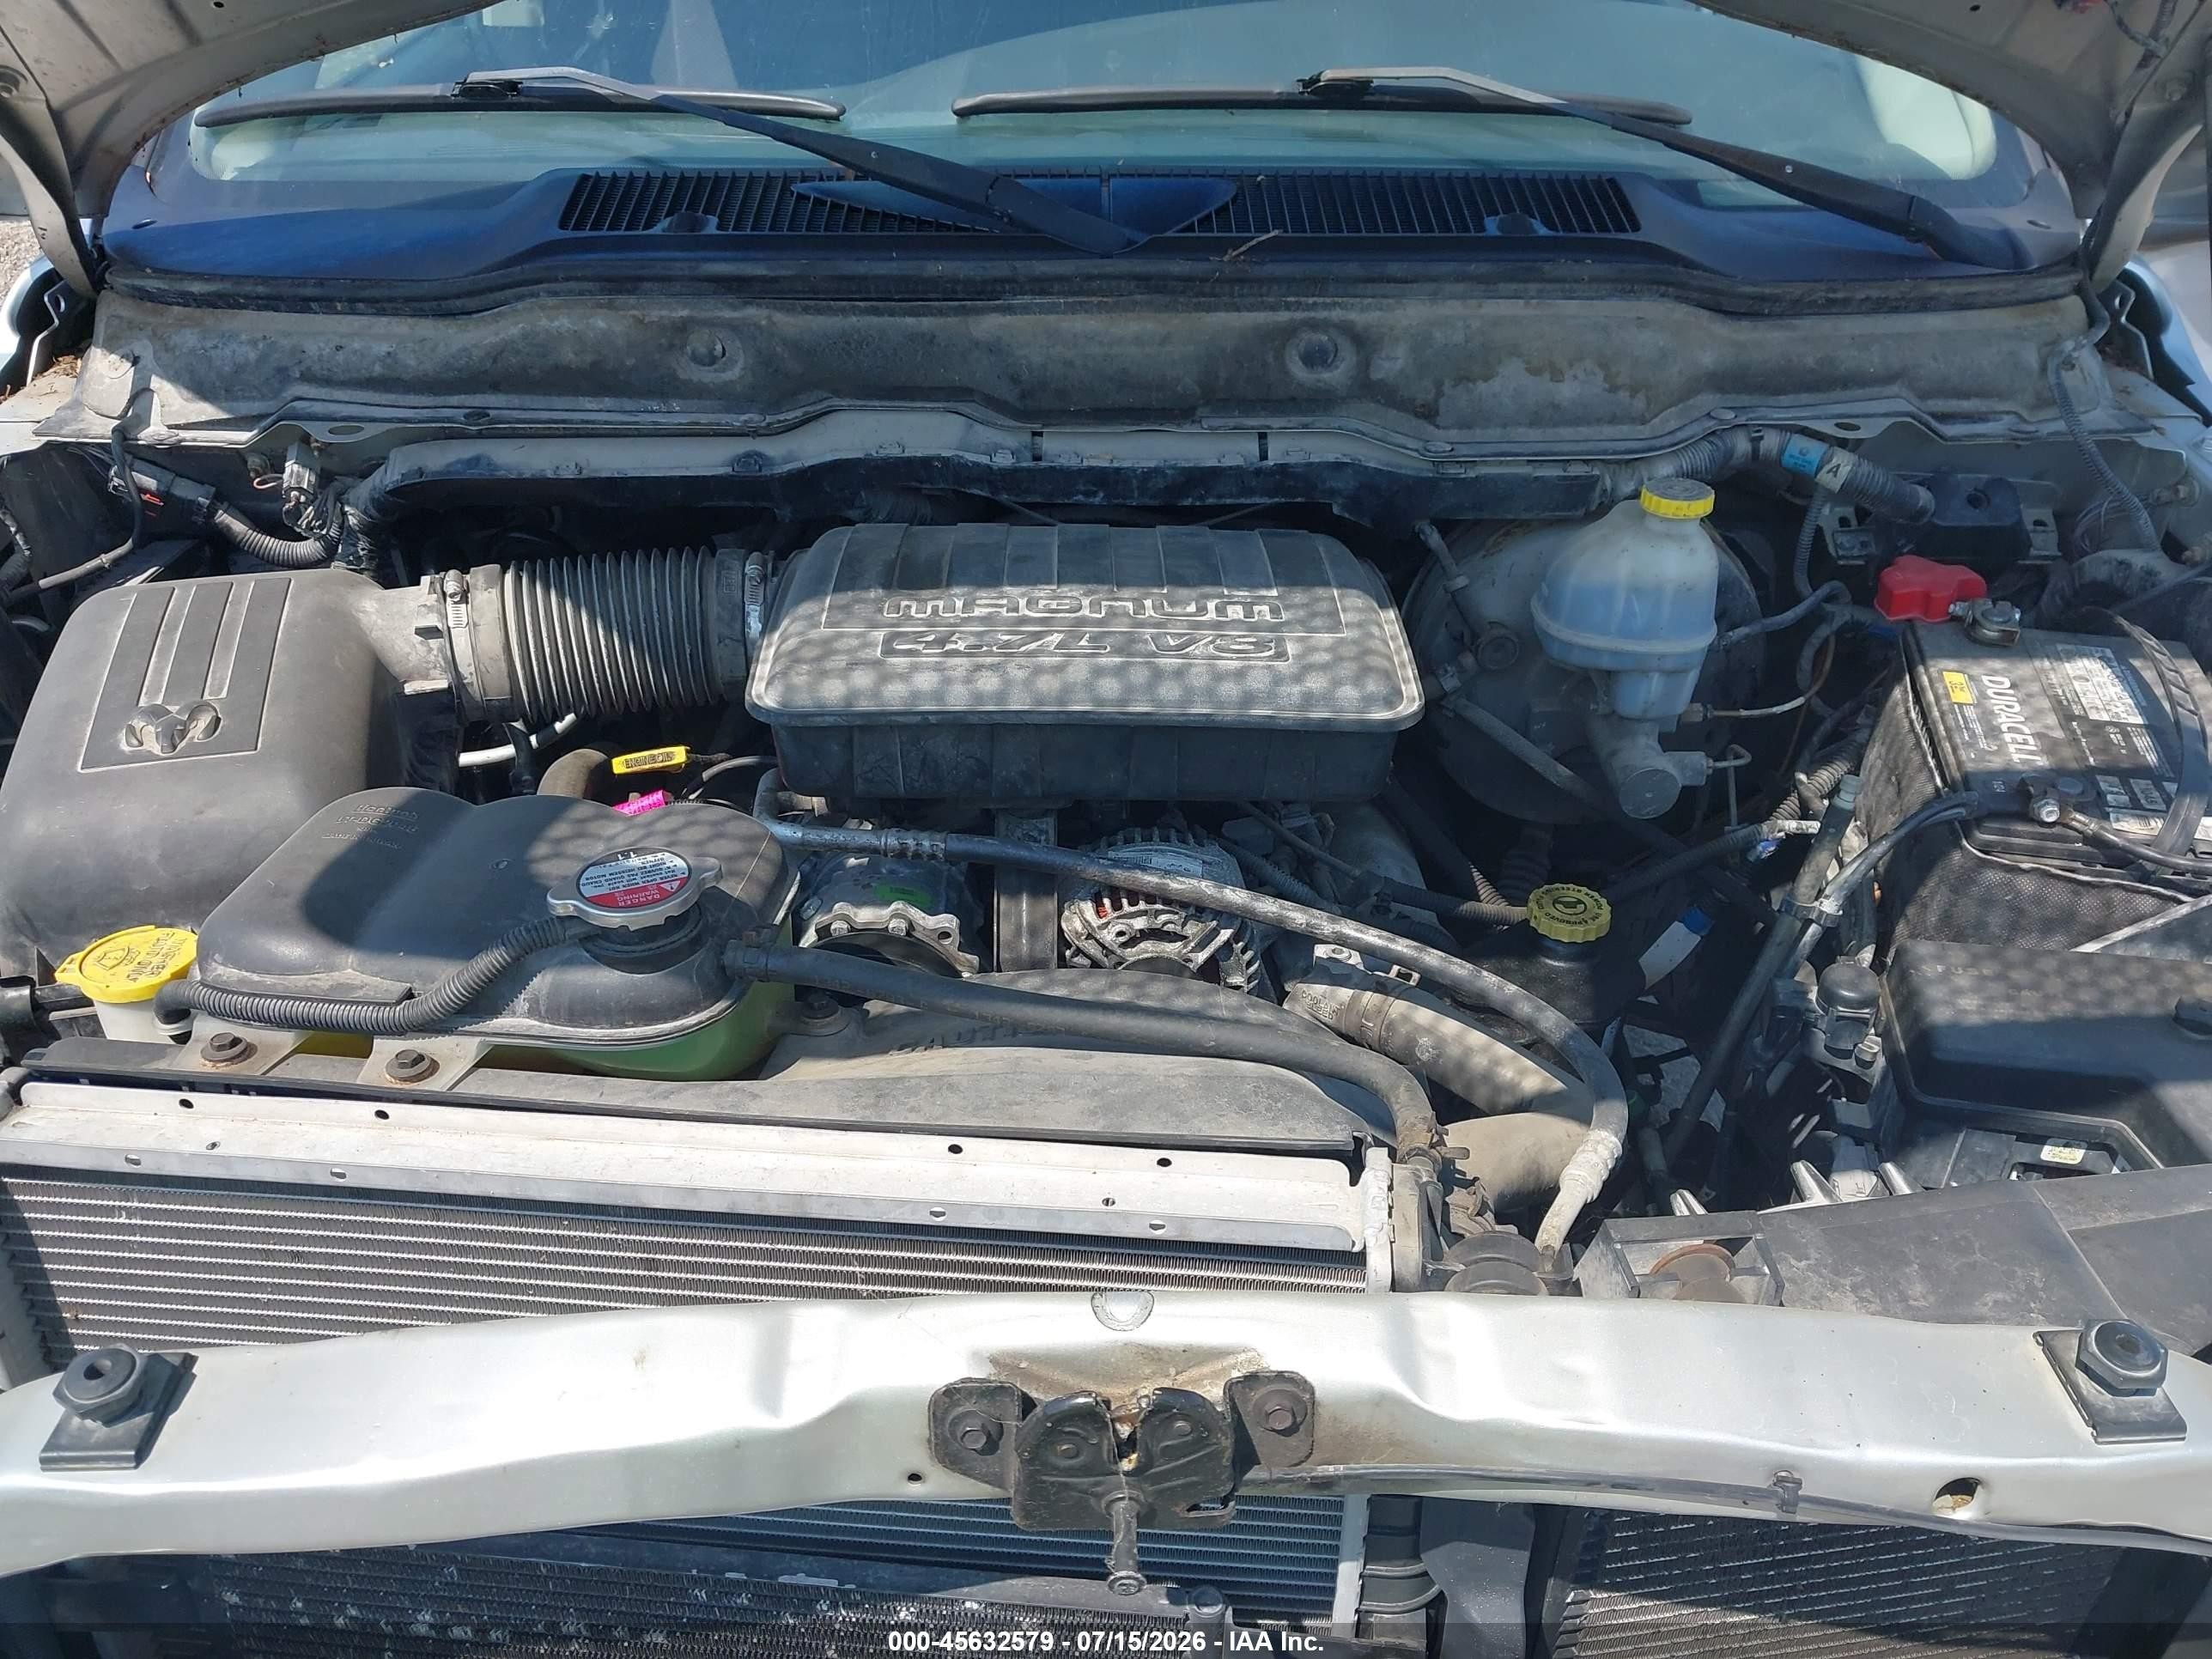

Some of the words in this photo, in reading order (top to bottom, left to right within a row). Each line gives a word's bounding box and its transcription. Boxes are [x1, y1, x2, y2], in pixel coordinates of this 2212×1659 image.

[1146, 632, 1274, 656] V8
[1981, 674, 2042, 763] DURACELL
[617, 893, 660, 907] DANGER
